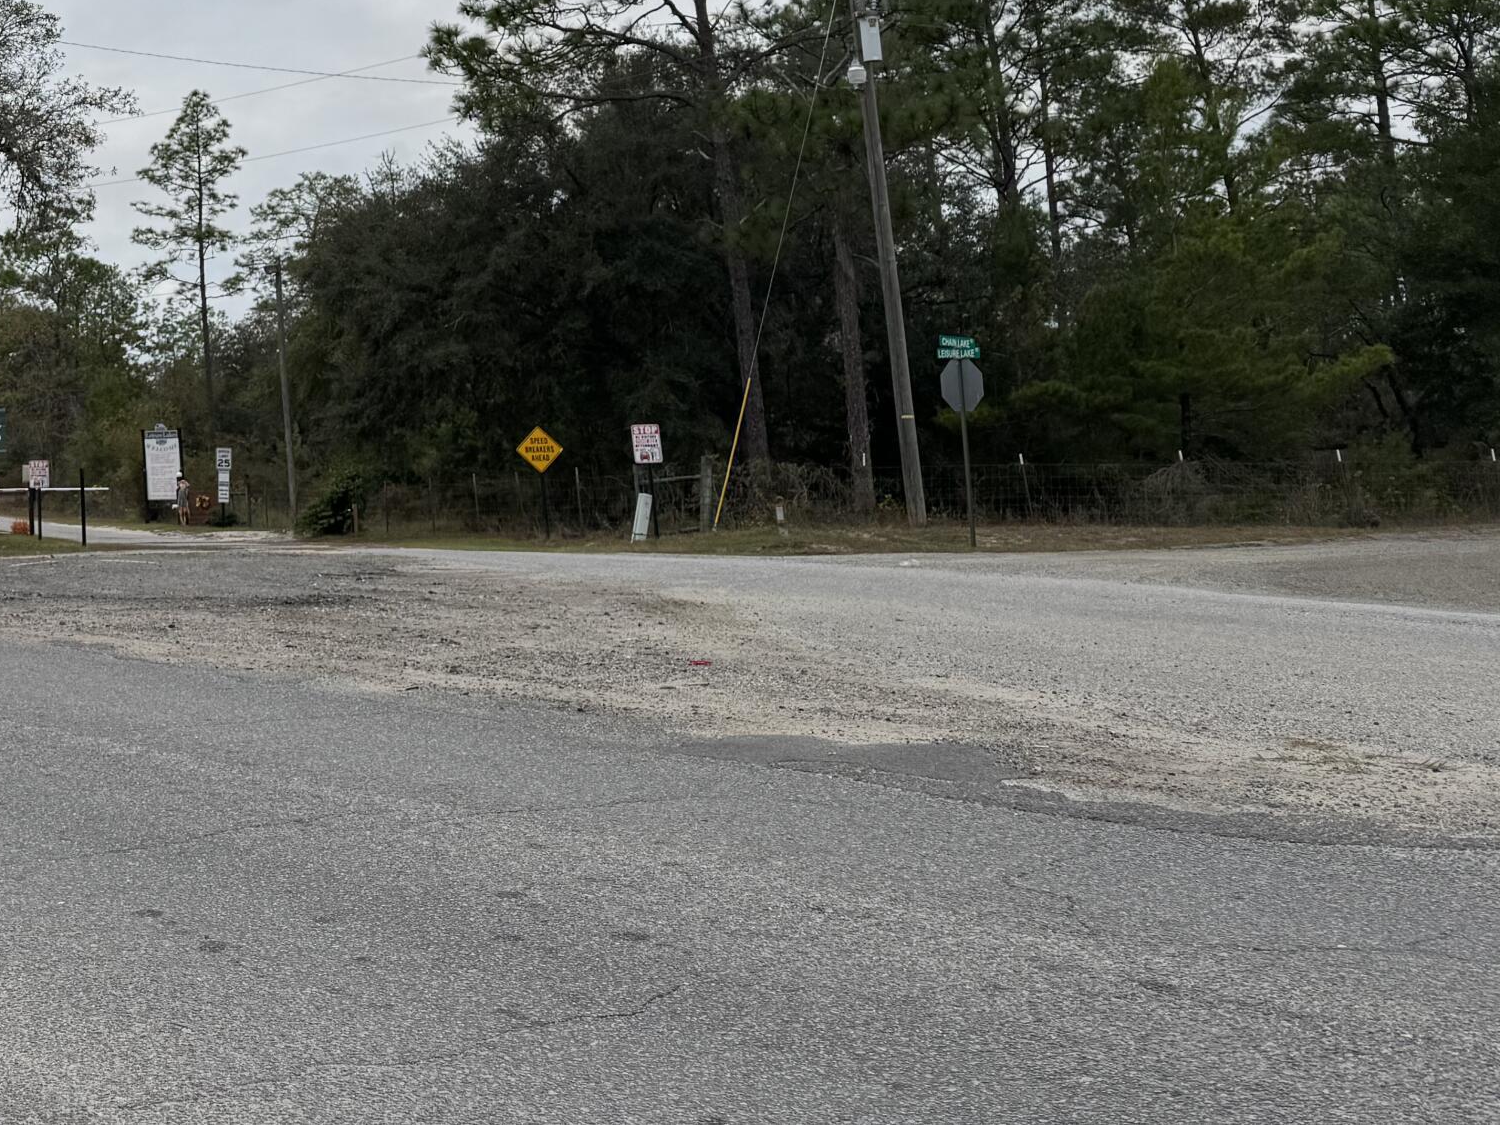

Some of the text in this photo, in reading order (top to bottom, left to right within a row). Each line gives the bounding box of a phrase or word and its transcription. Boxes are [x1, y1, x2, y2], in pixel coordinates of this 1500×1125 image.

[957, 338, 971, 348] LAKE
[937, 348, 975, 359] LEISURE LAKE
[632, 426, 658, 434] STOP
[524, 445, 555, 453] BREAKERS
[217, 458, 230, 467] 25
